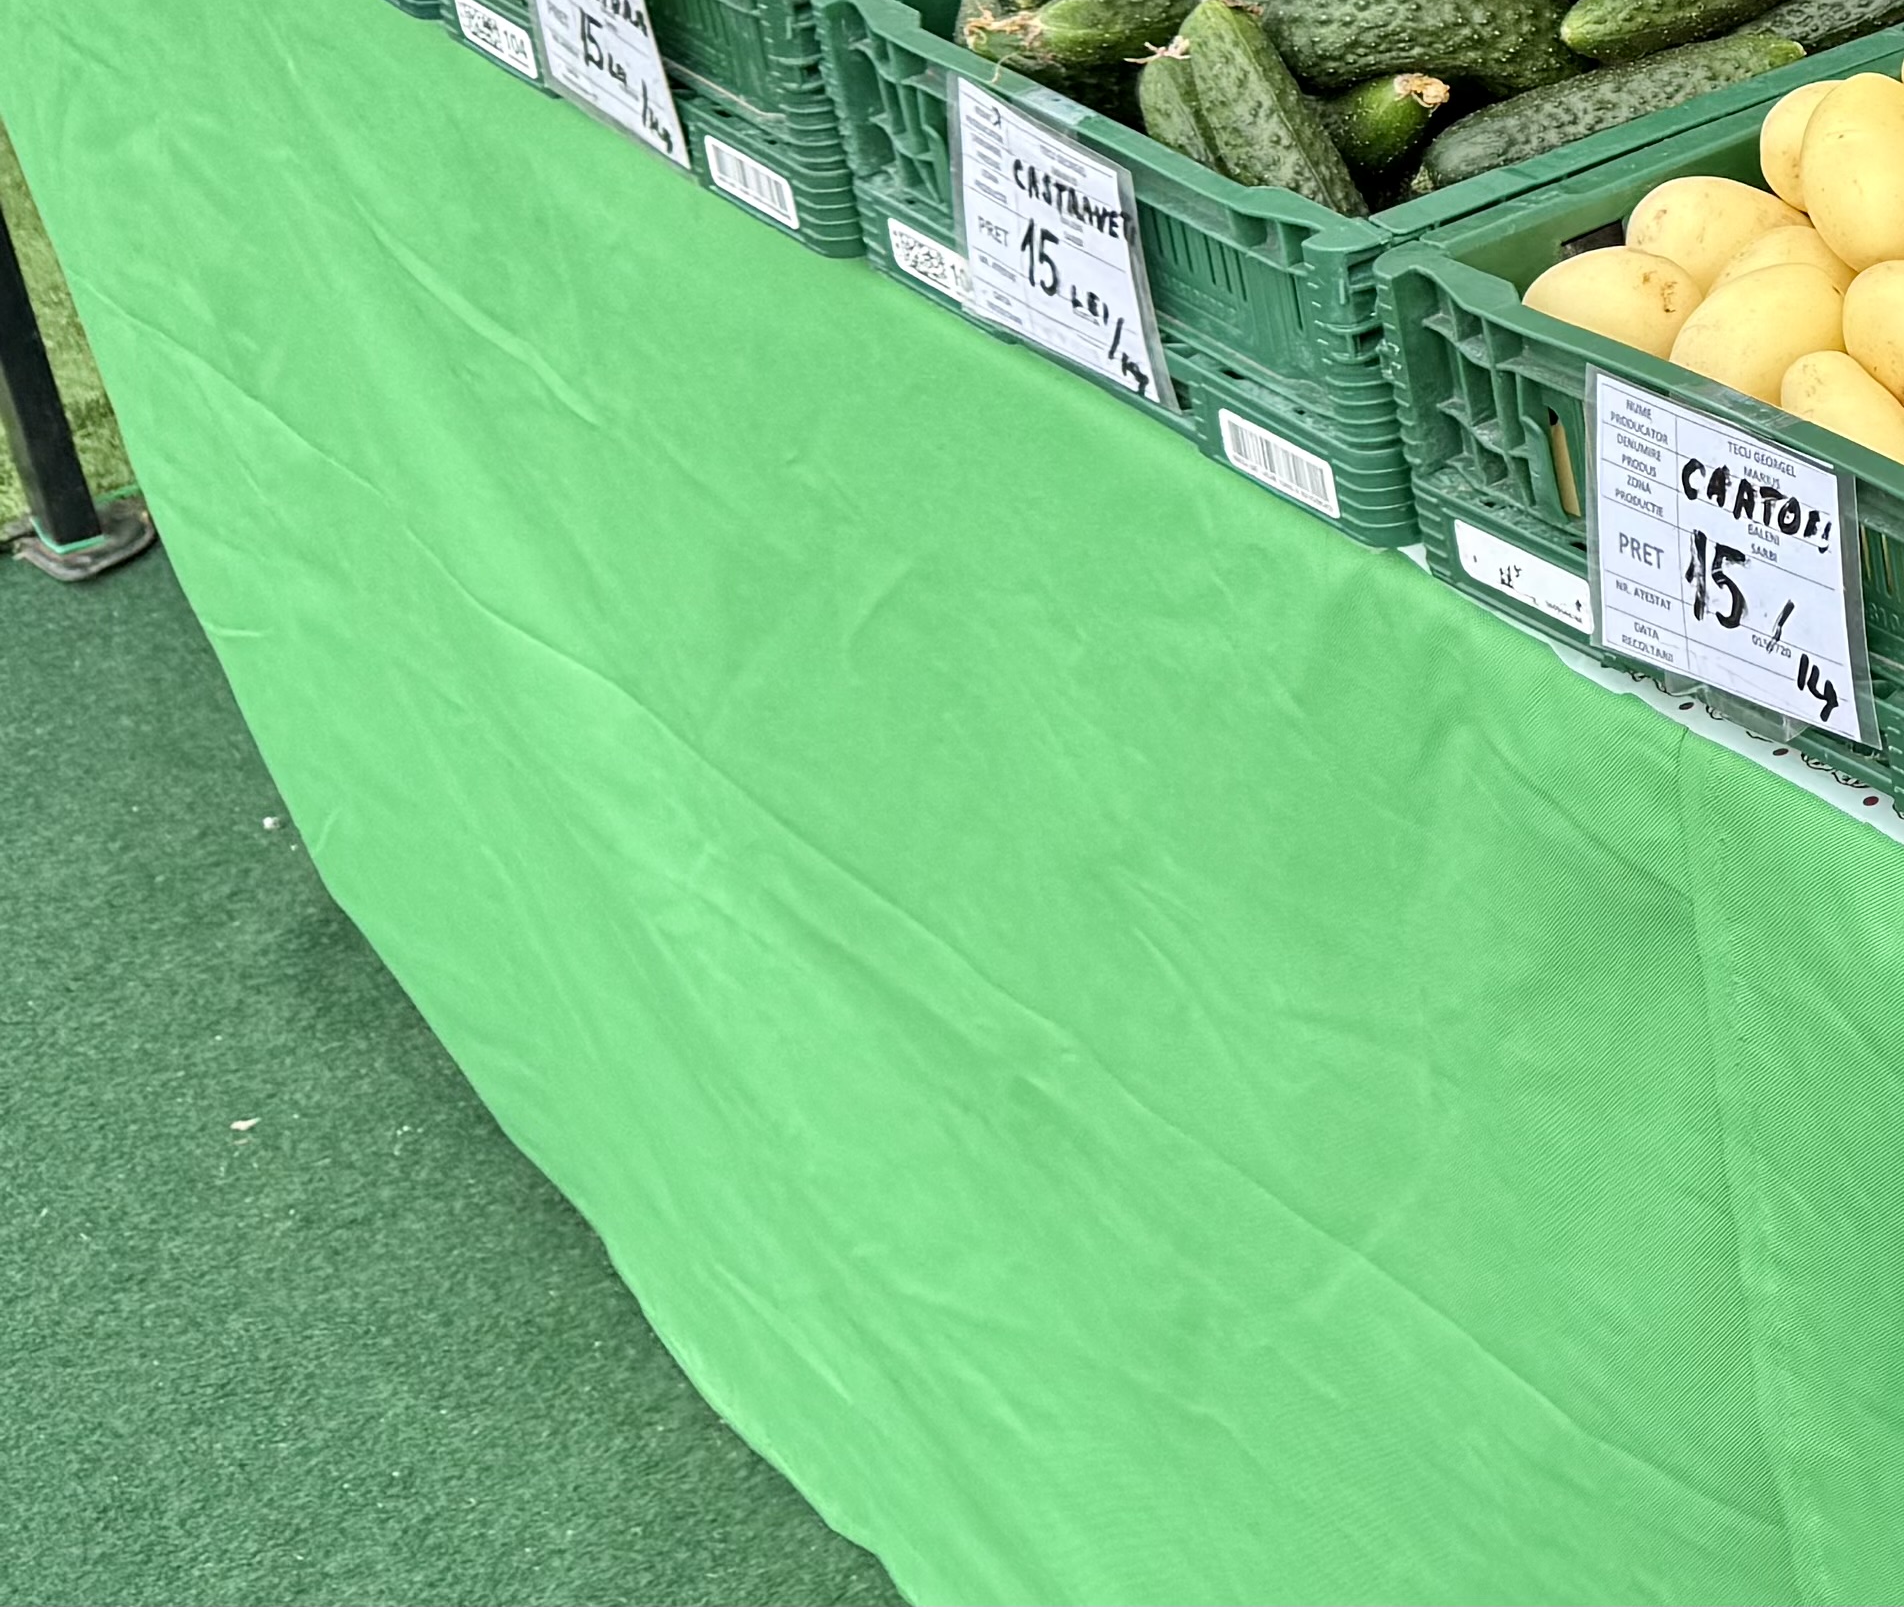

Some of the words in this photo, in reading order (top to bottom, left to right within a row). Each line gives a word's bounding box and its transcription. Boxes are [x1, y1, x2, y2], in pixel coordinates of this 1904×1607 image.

[1021, 218, 1060, 296] 15
[1610, 410, 1669, 446] PRODUCATOR
[1616, 433, 1662, 462] DENUMIRE
[1728, 440, 1752, 461] TECU
[1753, 449, 1797, 478] GEORGEL
[1621, 453, 1657, 478] PRODUS
[1614, 488, 1664, 518] PRODUCTIE
[1618, 532, 1665, 570] PRET
[1685, 530, 1750, 629] 15
[1633, 585, 1672, 611] ATESTAT
[1633, 621, 1659, 641] DATA
